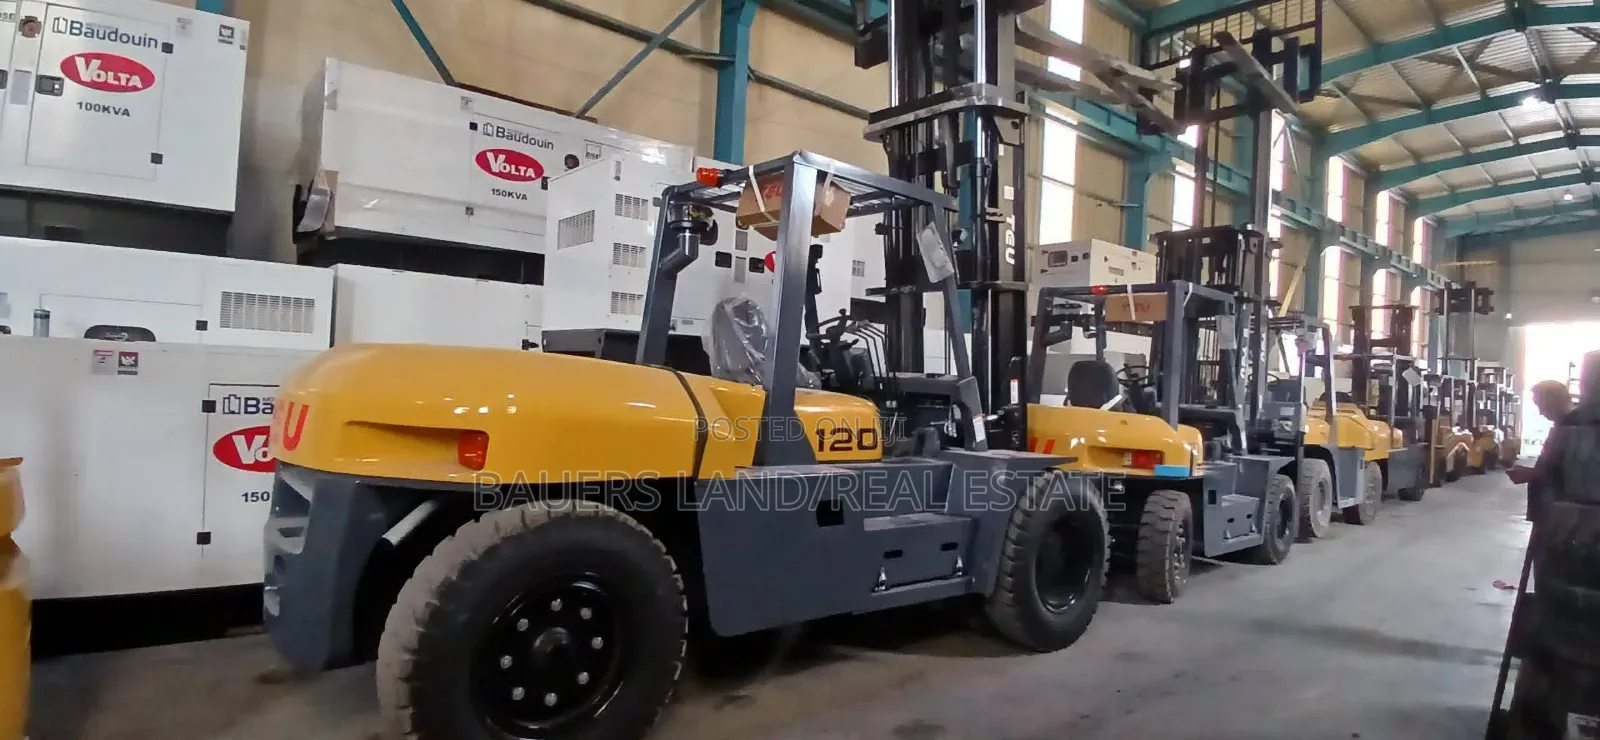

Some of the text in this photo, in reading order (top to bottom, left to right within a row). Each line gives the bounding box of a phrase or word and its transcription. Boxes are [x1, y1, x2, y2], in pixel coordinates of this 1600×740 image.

[70, 20, 157, 49] Baudouin
[77, 102, 131, 117] 100KVA
[496, 126, 554, 150] Baudouin
[491, 188, 528, 200] 150KVA
[1005, 215, 1015, 265] TEU
[815, 428, 878, 452] 120
[241, 491, 270, 502] 150
